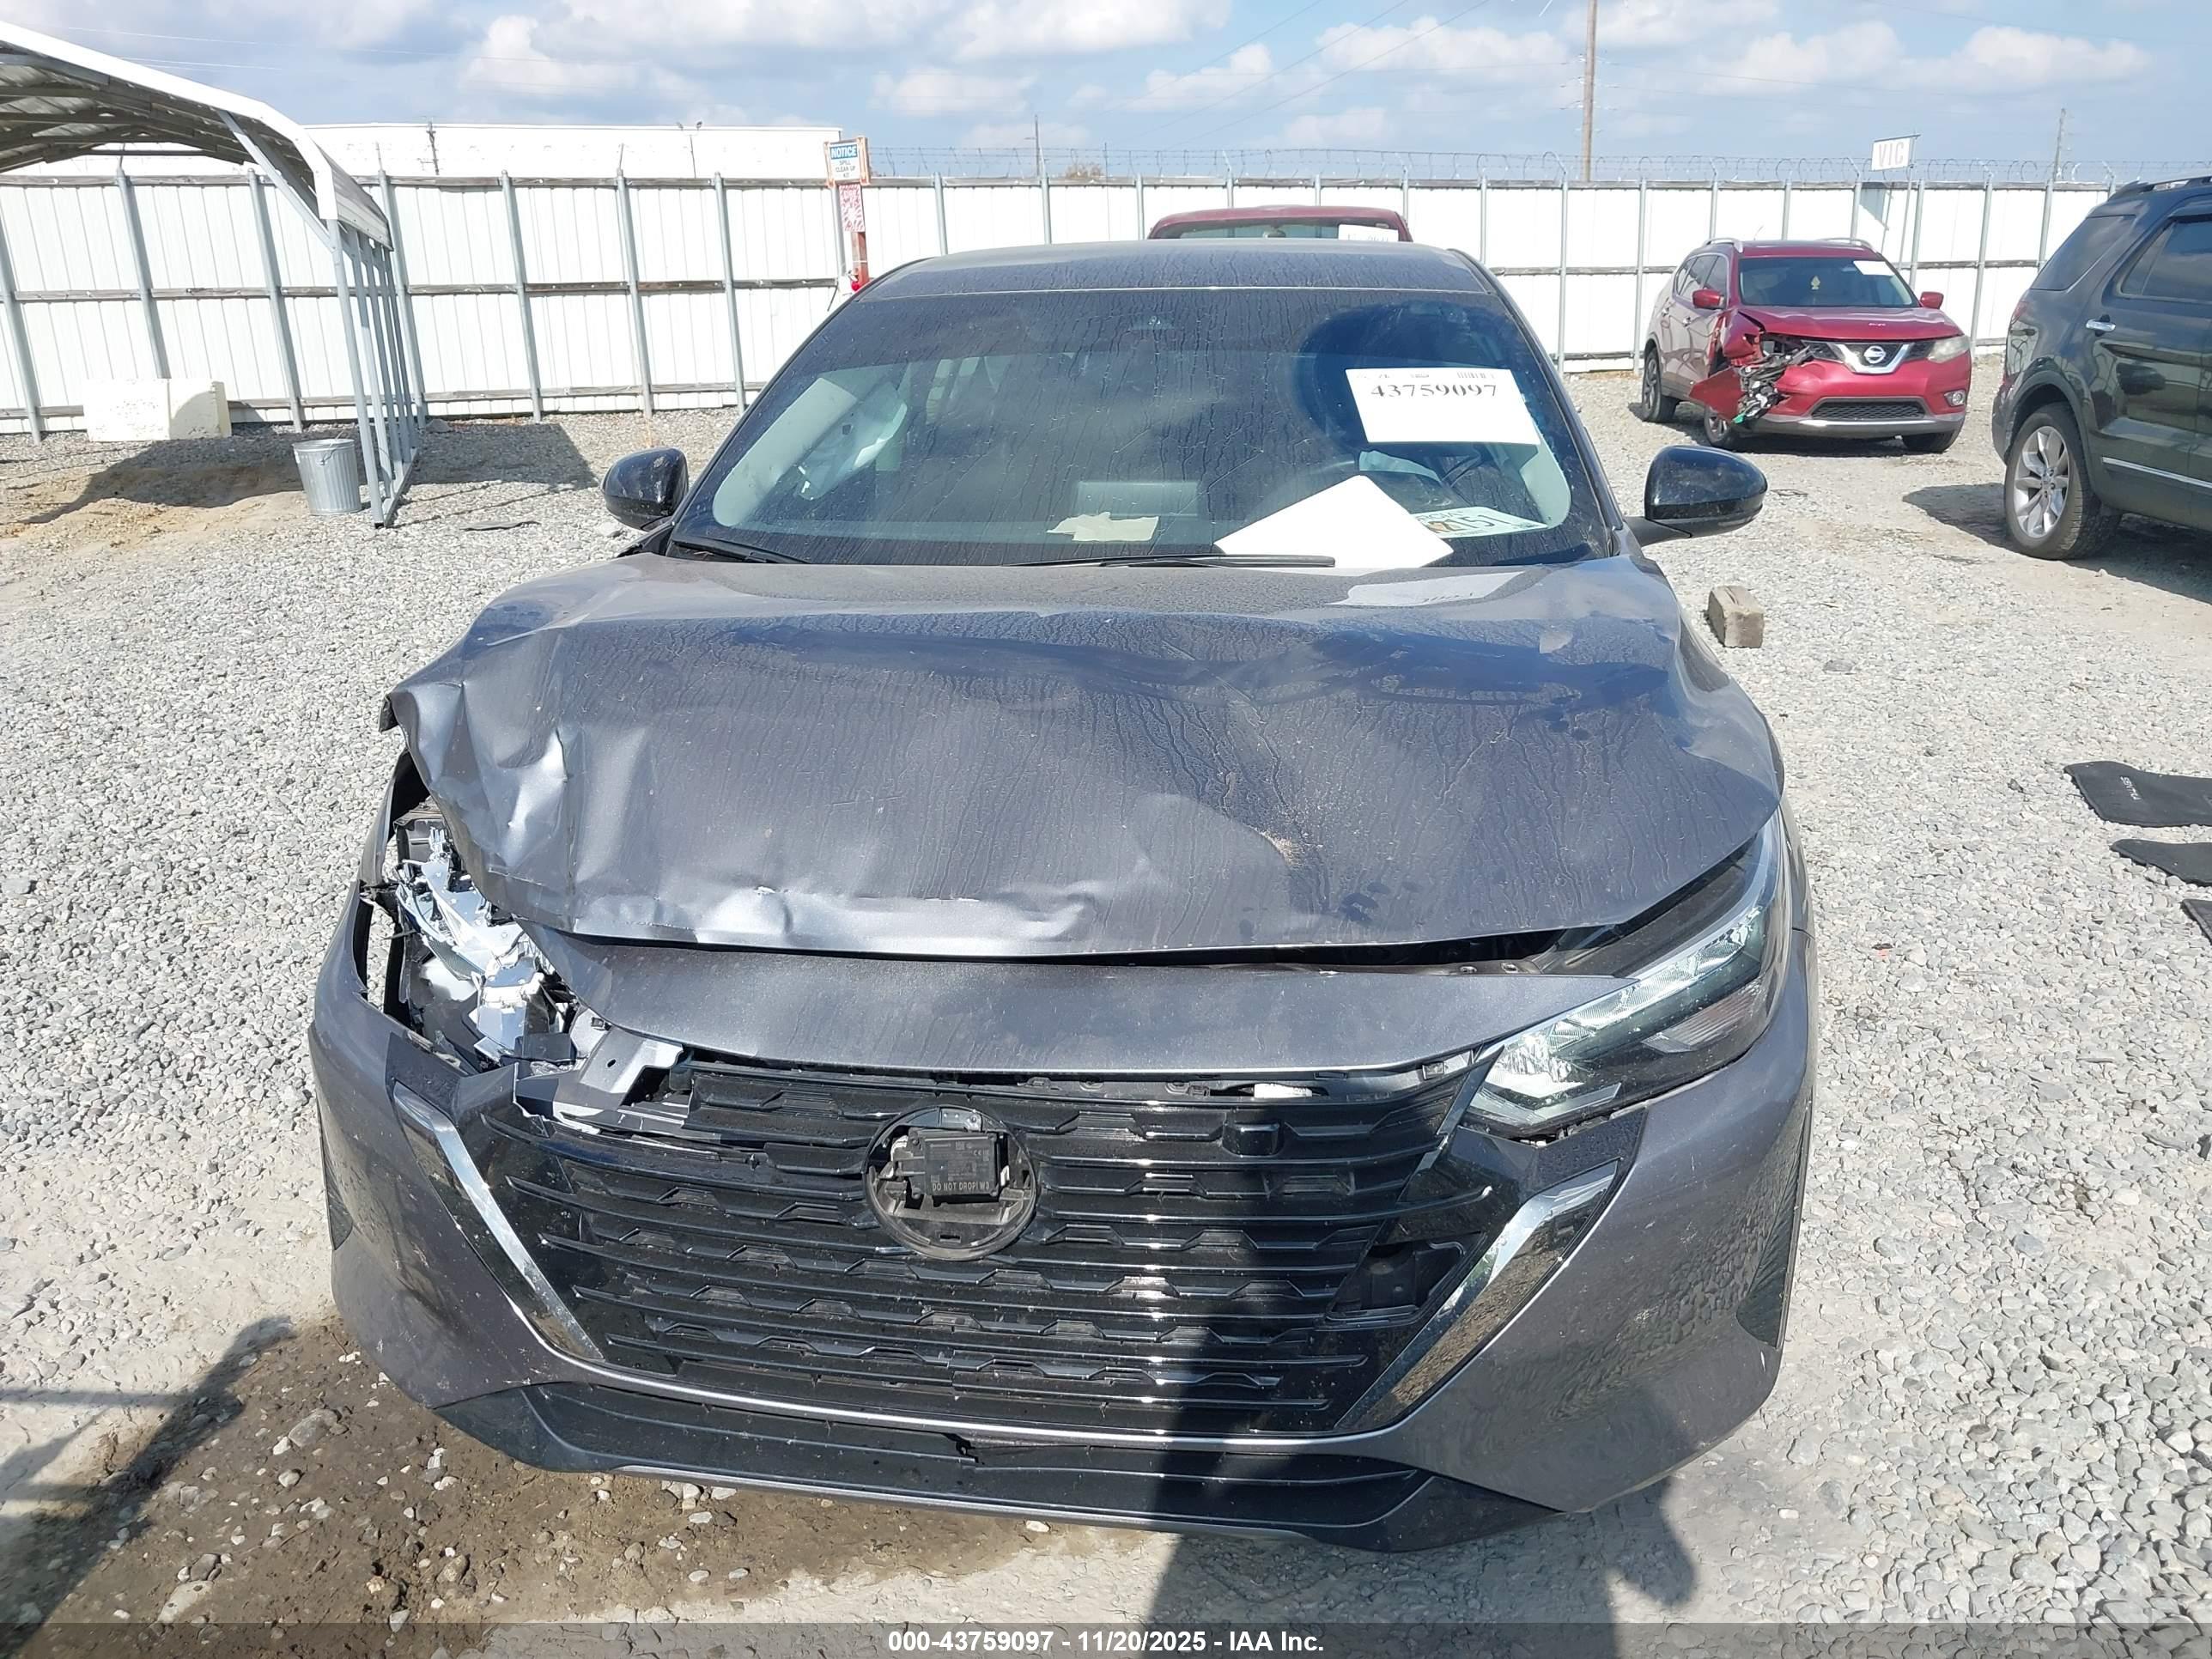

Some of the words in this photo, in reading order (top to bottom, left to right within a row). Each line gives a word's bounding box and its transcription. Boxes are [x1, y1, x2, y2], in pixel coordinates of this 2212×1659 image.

[830, 145, 857, 158] NOTICE
[1370, 384, 1497, 398] 43759097
[2120, 775, 2142, 800] SENTRA
[932, 1182, 942, 1192] DO
[943, 1182, 957, 1191] NOT
